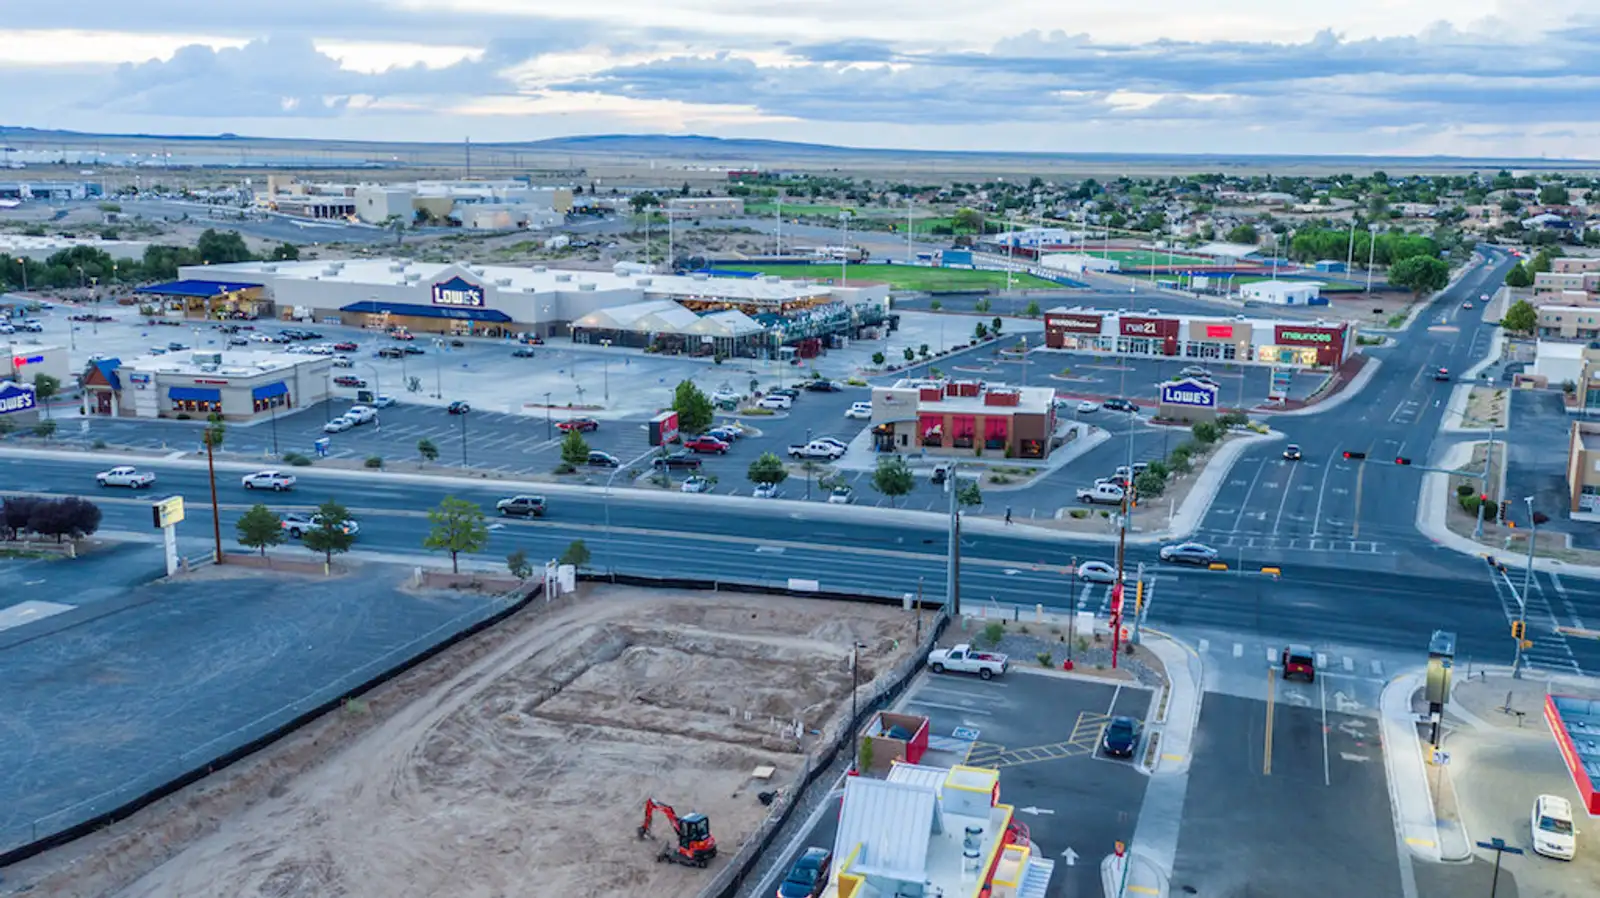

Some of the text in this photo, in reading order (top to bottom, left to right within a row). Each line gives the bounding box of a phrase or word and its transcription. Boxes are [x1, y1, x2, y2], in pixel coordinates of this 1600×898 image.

[435, 287, 480, 305] LOWE'S
[0, 392, 33, 412] OWE'S
[1165, 388, 1211, 405] LOWE'S
